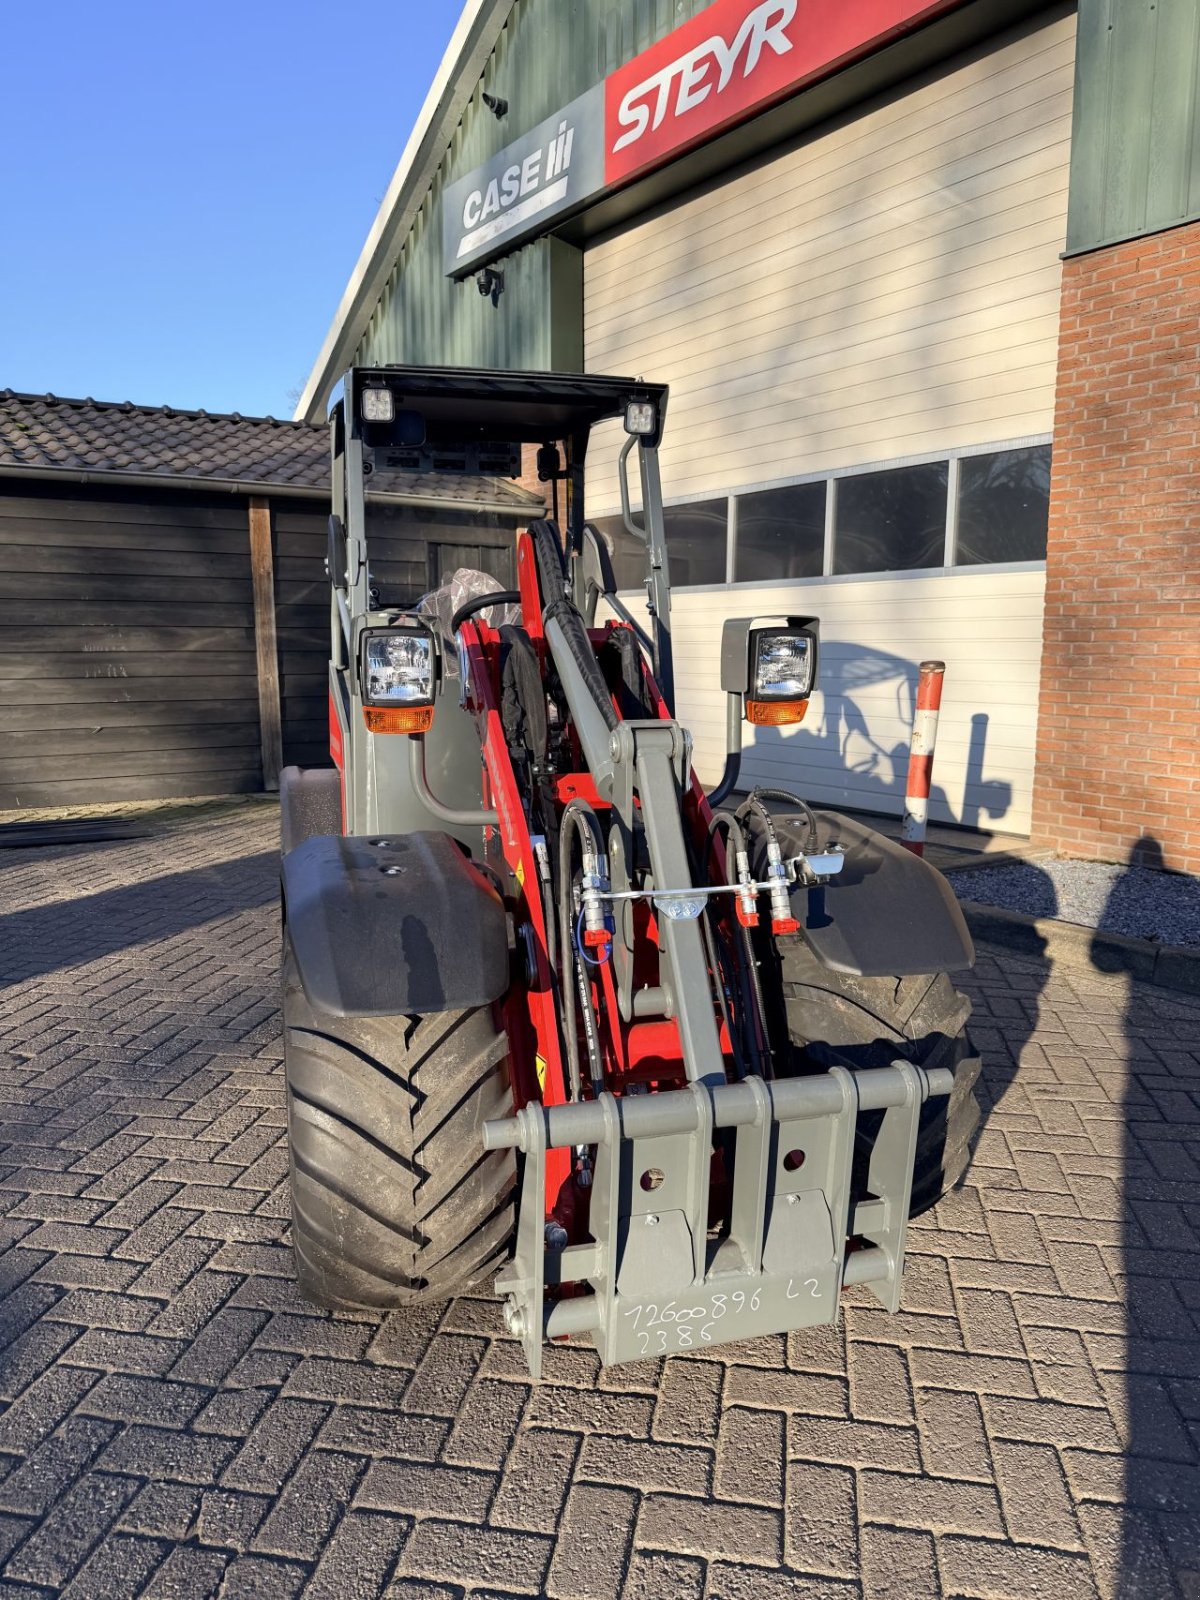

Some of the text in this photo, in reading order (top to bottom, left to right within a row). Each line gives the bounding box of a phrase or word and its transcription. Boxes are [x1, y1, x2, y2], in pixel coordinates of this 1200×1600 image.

[612, 0, 798, 154] STEYR
[463, 148, 542, 229] CASE
[637, 1321, 716, 1355] 2386
